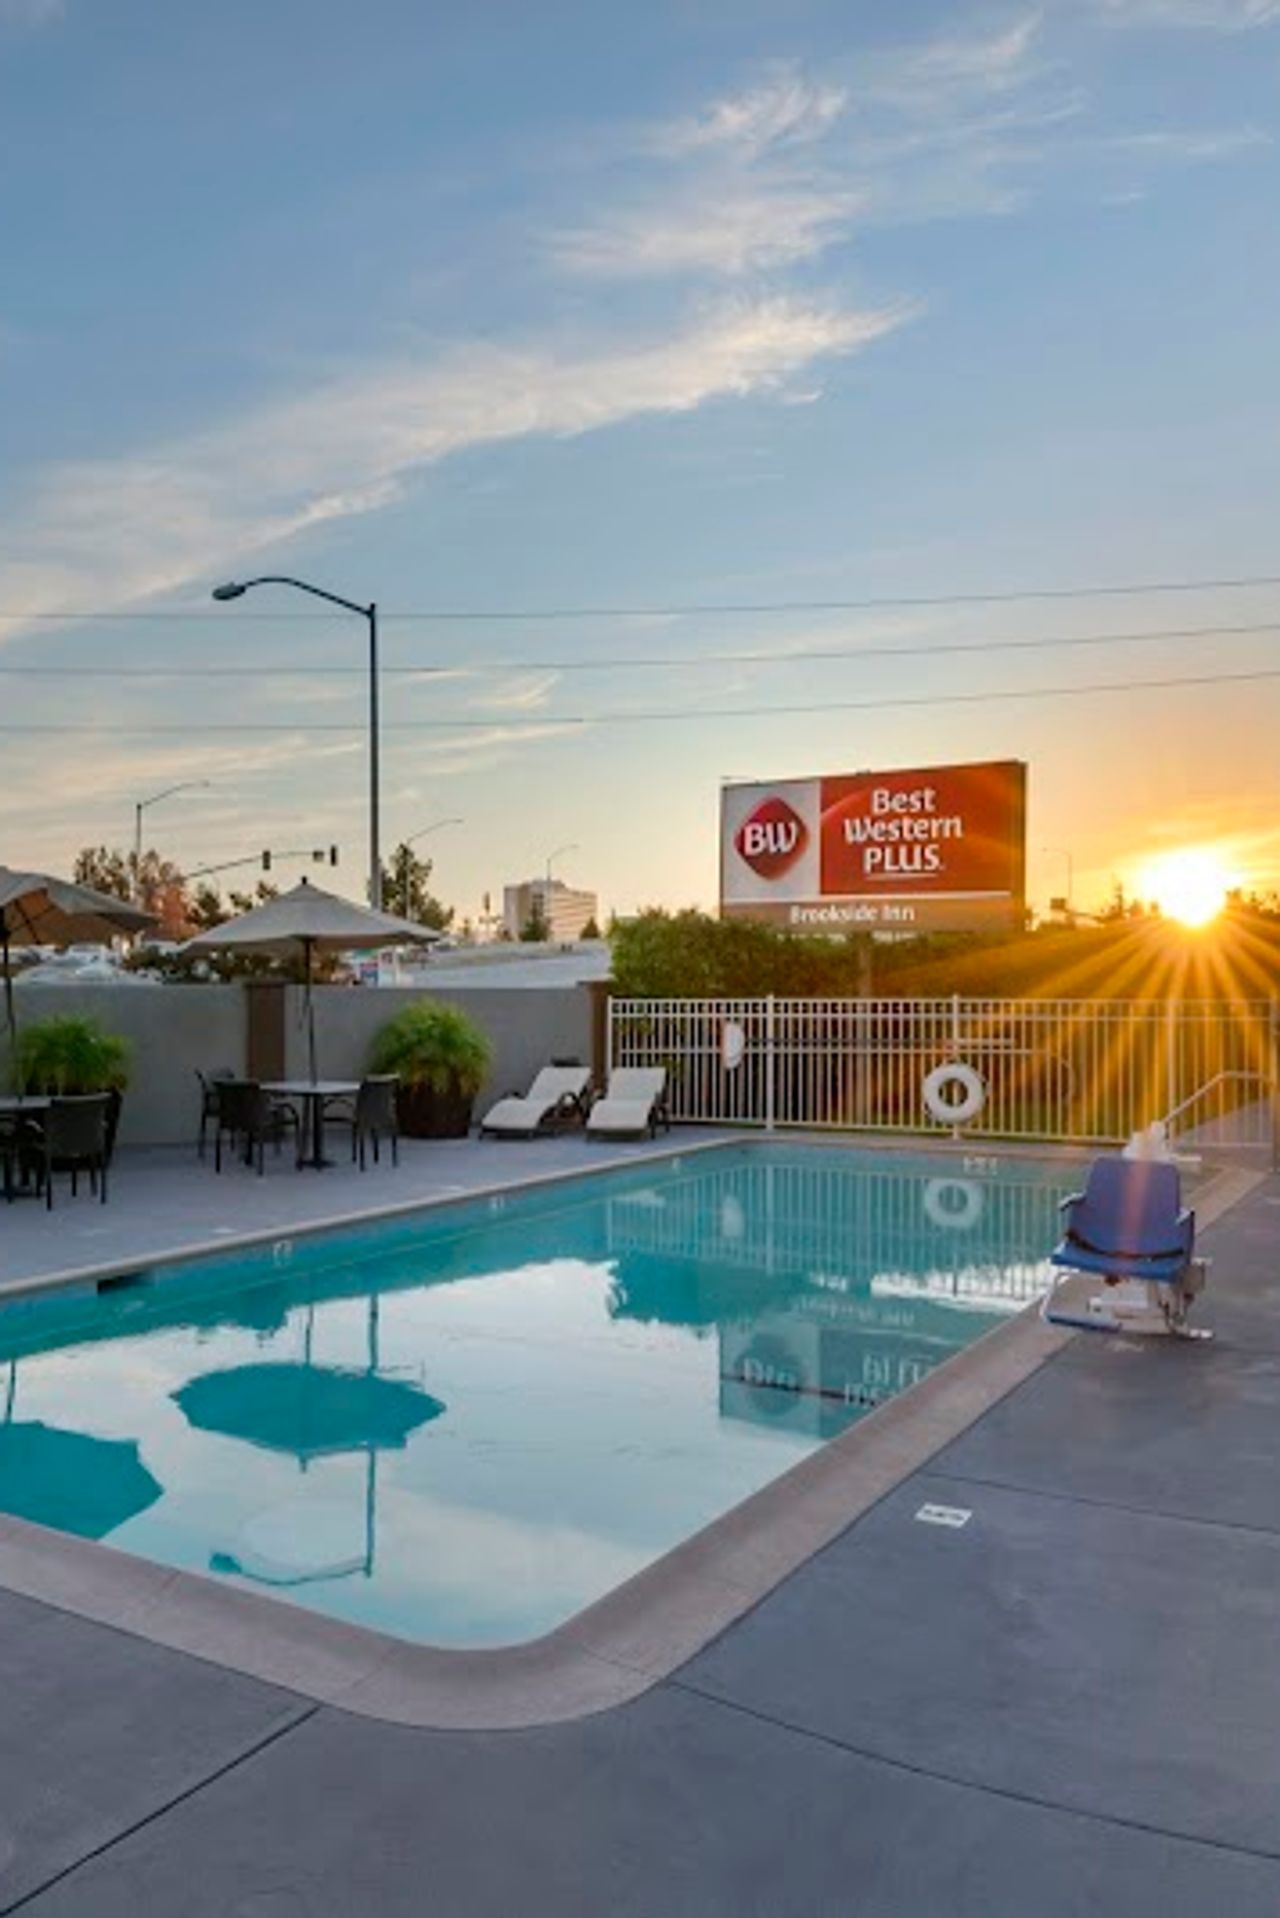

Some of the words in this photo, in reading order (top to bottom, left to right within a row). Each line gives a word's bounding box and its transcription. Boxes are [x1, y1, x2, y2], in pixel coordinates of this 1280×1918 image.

[872, 787, 936, 815] Best
[743, 821, 798, 857] BW
[843, 815, 963, 845] Western
[863, 843, 941, 874] PLUS
[882, 903, 916, 922] Inn
